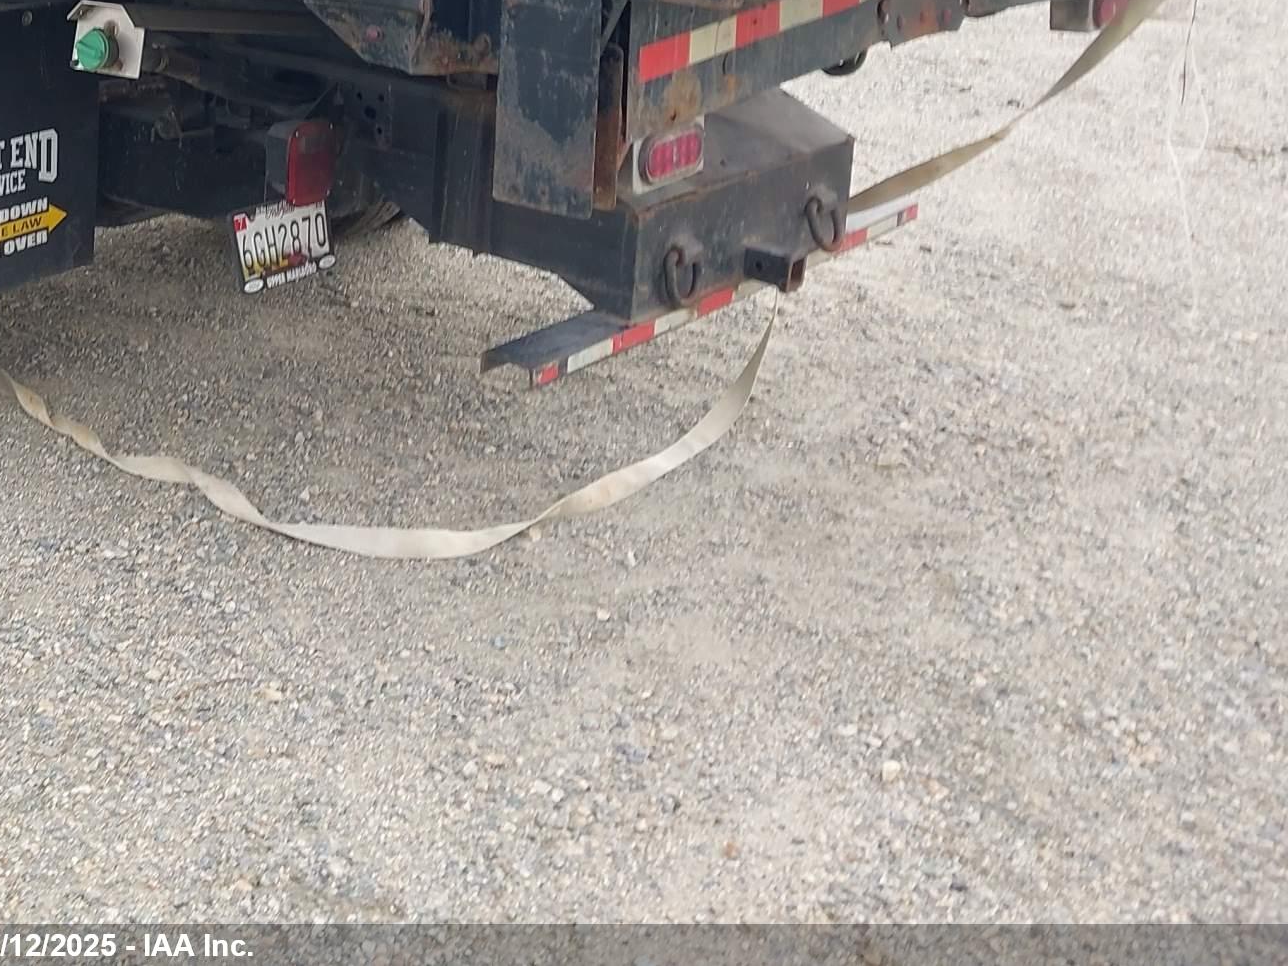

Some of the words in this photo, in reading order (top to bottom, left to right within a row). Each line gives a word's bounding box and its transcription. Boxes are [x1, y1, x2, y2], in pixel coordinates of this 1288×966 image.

[10, 128, 59, 183] END
[0, 196, 49, 225] DOWN
[13, 216, 43, 234] LAW
[3, 229, 49, 256] OVER
